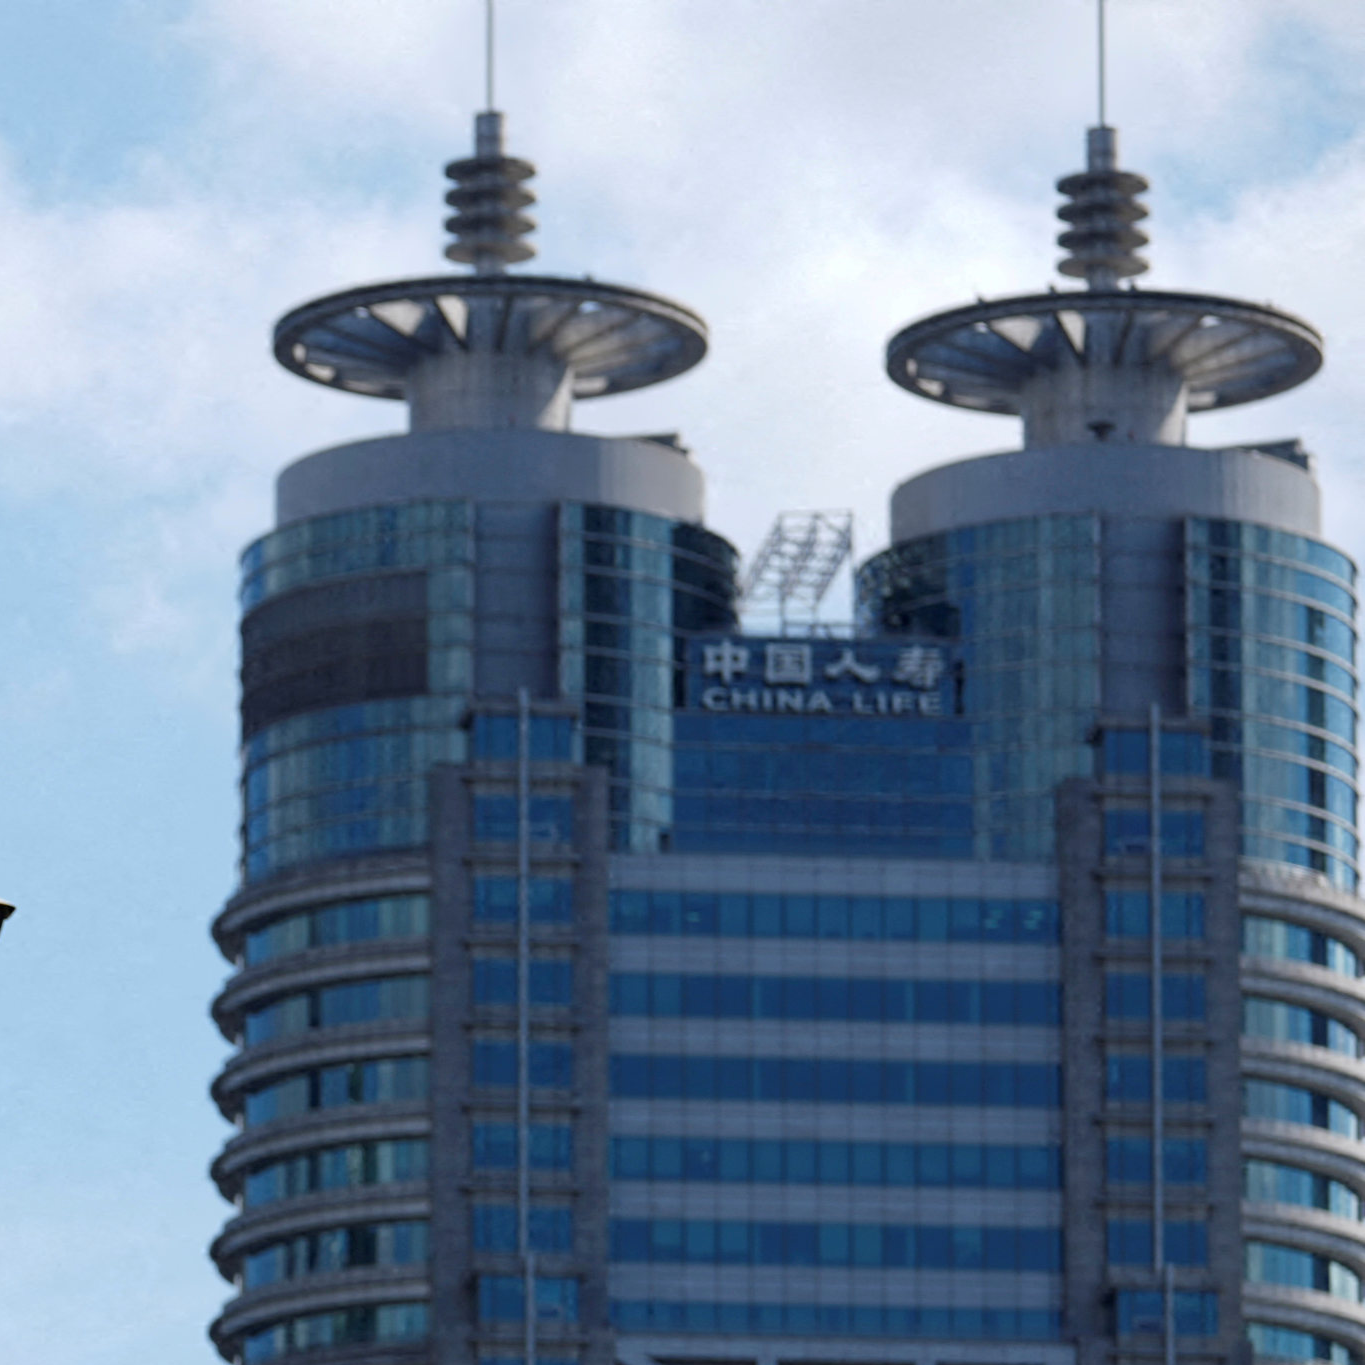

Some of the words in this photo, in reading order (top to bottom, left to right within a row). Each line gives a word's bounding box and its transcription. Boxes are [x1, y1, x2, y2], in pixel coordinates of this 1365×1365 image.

[702, 641, 945, 688] 中国人寿
[702, 687, 833, 713] CHINA
[852, 689, 943, 716] LIFE
